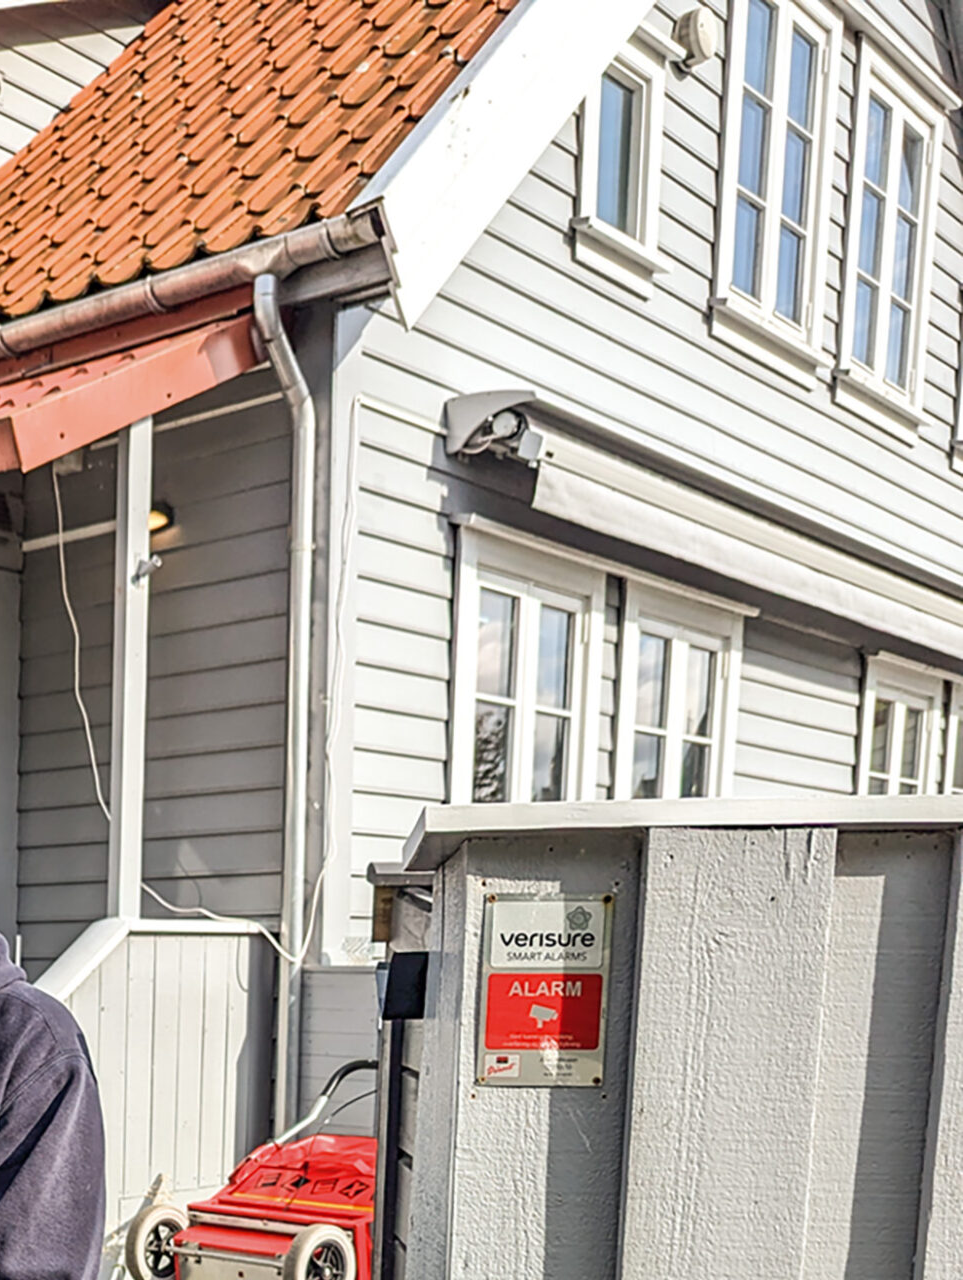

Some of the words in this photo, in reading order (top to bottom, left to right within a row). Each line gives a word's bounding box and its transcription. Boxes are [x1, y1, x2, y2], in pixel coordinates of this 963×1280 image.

[500, 932, 595, 948] verisure
[506, 951, 543, 962] SMART
[543, 951, 588, 962] ALARMS
[508, 980, 582, 997] ALARM
